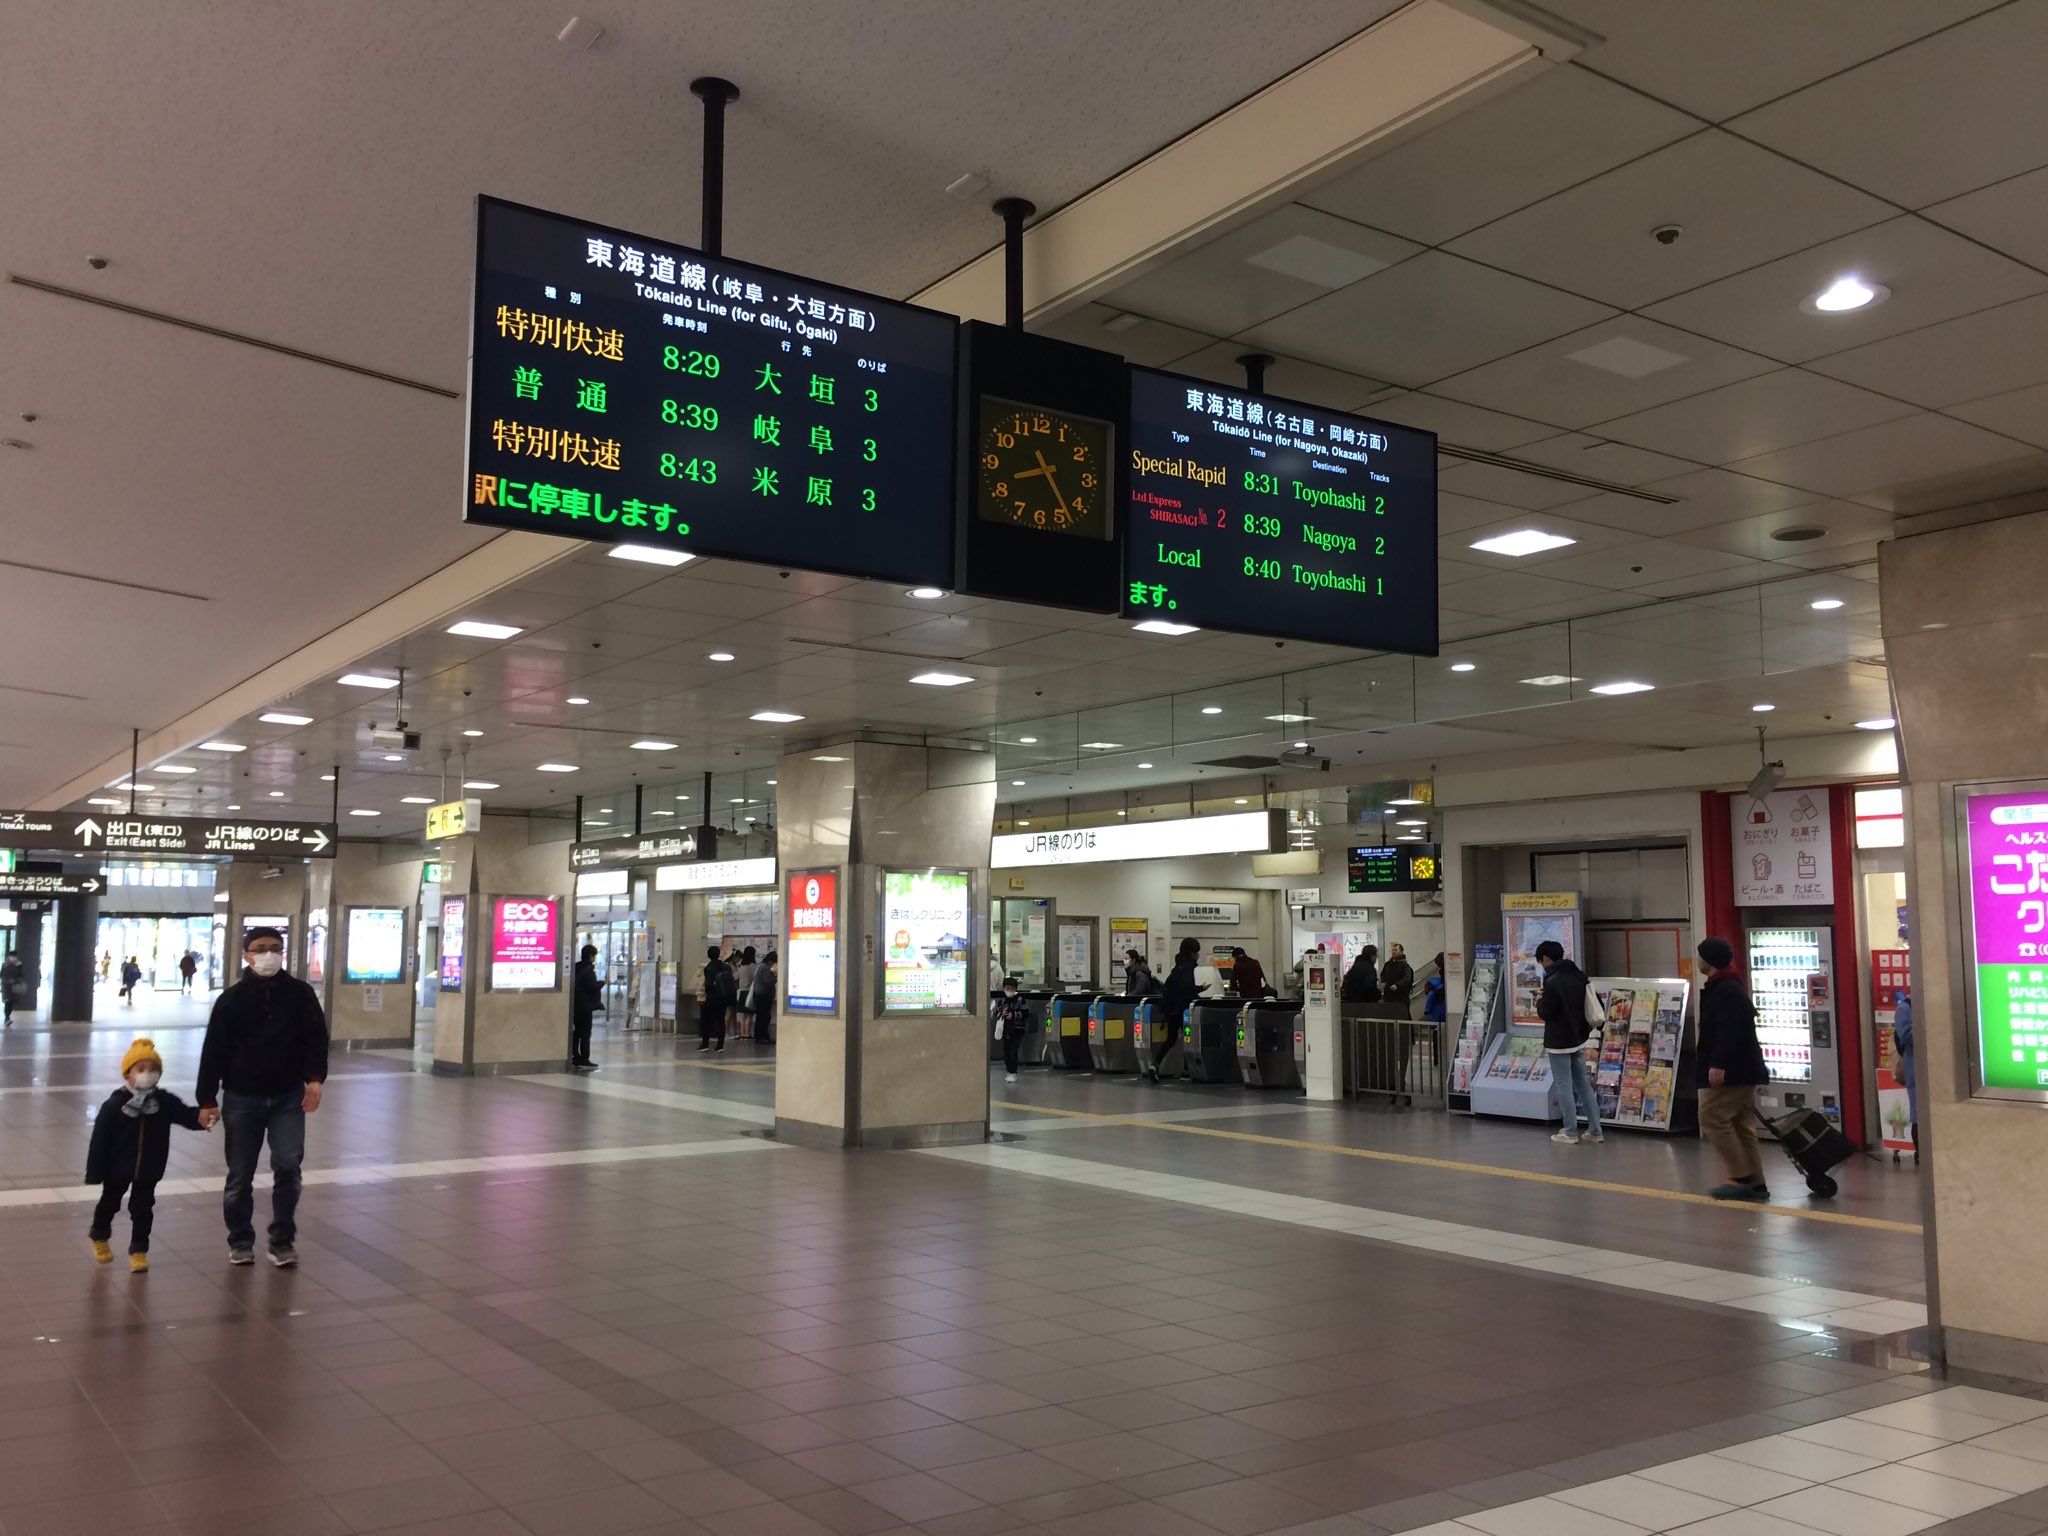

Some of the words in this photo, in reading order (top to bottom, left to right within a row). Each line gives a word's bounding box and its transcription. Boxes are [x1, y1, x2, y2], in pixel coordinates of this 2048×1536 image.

[586, 238, 876, 333] 東海道線（岐阜・大垣方面）
[544, 286, 581, 304] 種別
[635, 282, 692, 308] Tōkaidō
[698, 299, 727, 317] Line
[731, 307, 756, 324] (for
[760, 313, 791, 334] Gifu,
[796, 321, 838, 345] Ōgaki)
[662, 313, 708, 334] 発車時刻
[781, 340, 812, 357] 行先
[496, 305, 625, 361] 特別快速
[663, 345, 720, 379] 8:29
[755, 363, 835, 405] 大垣
[864, 389, 879, 412] 3
[857, 358, 887, 373] のりば
[512, 366, 608, 414] 普通
[661, 399, 719, 431] 8:39
[753, 414, 834, 455] 岐阜
[863, 438, 877, 462] 3
[1186, 389, 1388, 452] 東海道線（名古屋・岡崎方面）
[1014, 419, 1030, 436] 11
[1032, 417, 1050, 434] 12
[996, 432, 1015, 449] 10
[1058, 428, 1066, 443] 1
[1212, 420, 1250, 438] Tōkaidō
[1253, 429, 1272, 443] Line
[1275, 434, 1291, 447] (for
[1294, 438, 1329, 456] Nagoya,
[1331, 446, 1368, 465] Okazaki)
[986, 454, 999, 470] 9
[1073, 447, 1085, 462] 2
[1171, 431, 1190, 443] Type
[1249, 447, 1266, 458] Time
[1312, 460, 1347, 475] Destination
[1370, 471, 1389, 483] Tracks
[492, 419, 622, 471] 特別快速
[660, 453, 717, 484] 8:43
[751, 467, 833, 506] 米原
[862, 488, 876, 511] 3
[1081, 473, 1093, 488] 3
[1132, 450, 1183, 478] Special
[1187, 460, 1226, 488] Rapid
[1244, 471, 1279, 496] 8:31
[1292, 480, 1366, 512] Toyohashi
[1375, 496, 1385, 515] 2
[995, 482, 1008, 498] 8
[1014, 501, 1026, 517] 7
[1072, 496, 1084, 512] 4
[1033, 510, 1046, 525] 6
[1053, 508, 1066, 524] 5
[1150, 508, 1197, 527] SHIRASAGI
[1217, 508, 1226, 529] 2
[1243, 514, 1281, 538] 8:39
[1302, 524, 1357, 554] Nagoya
[1375, 536, 1385, 555] 2
[1158, 543, 1201, 568] Local
[1243, 556, 1281, 580] 8:40
[1292, 564, 1366, 593] Toyohashi
[1376, 577, 1383, 596] 1
[1129, 581, 1177, 610] ます。
[205, 825, 301, 843] JR線のりば
[1744, 829, 1778, 840] おにぎり
[106, 838, 128, 847] Exit
[129, 838, 157, 848] (East
[159, 838, 186, 848] Side)
[204, 841, 220, 850] JR
[223, 841, 255, 851] Lines
[1794, 884, 1822, 893] たばこ
[504, 903, 549, 920] ECC
